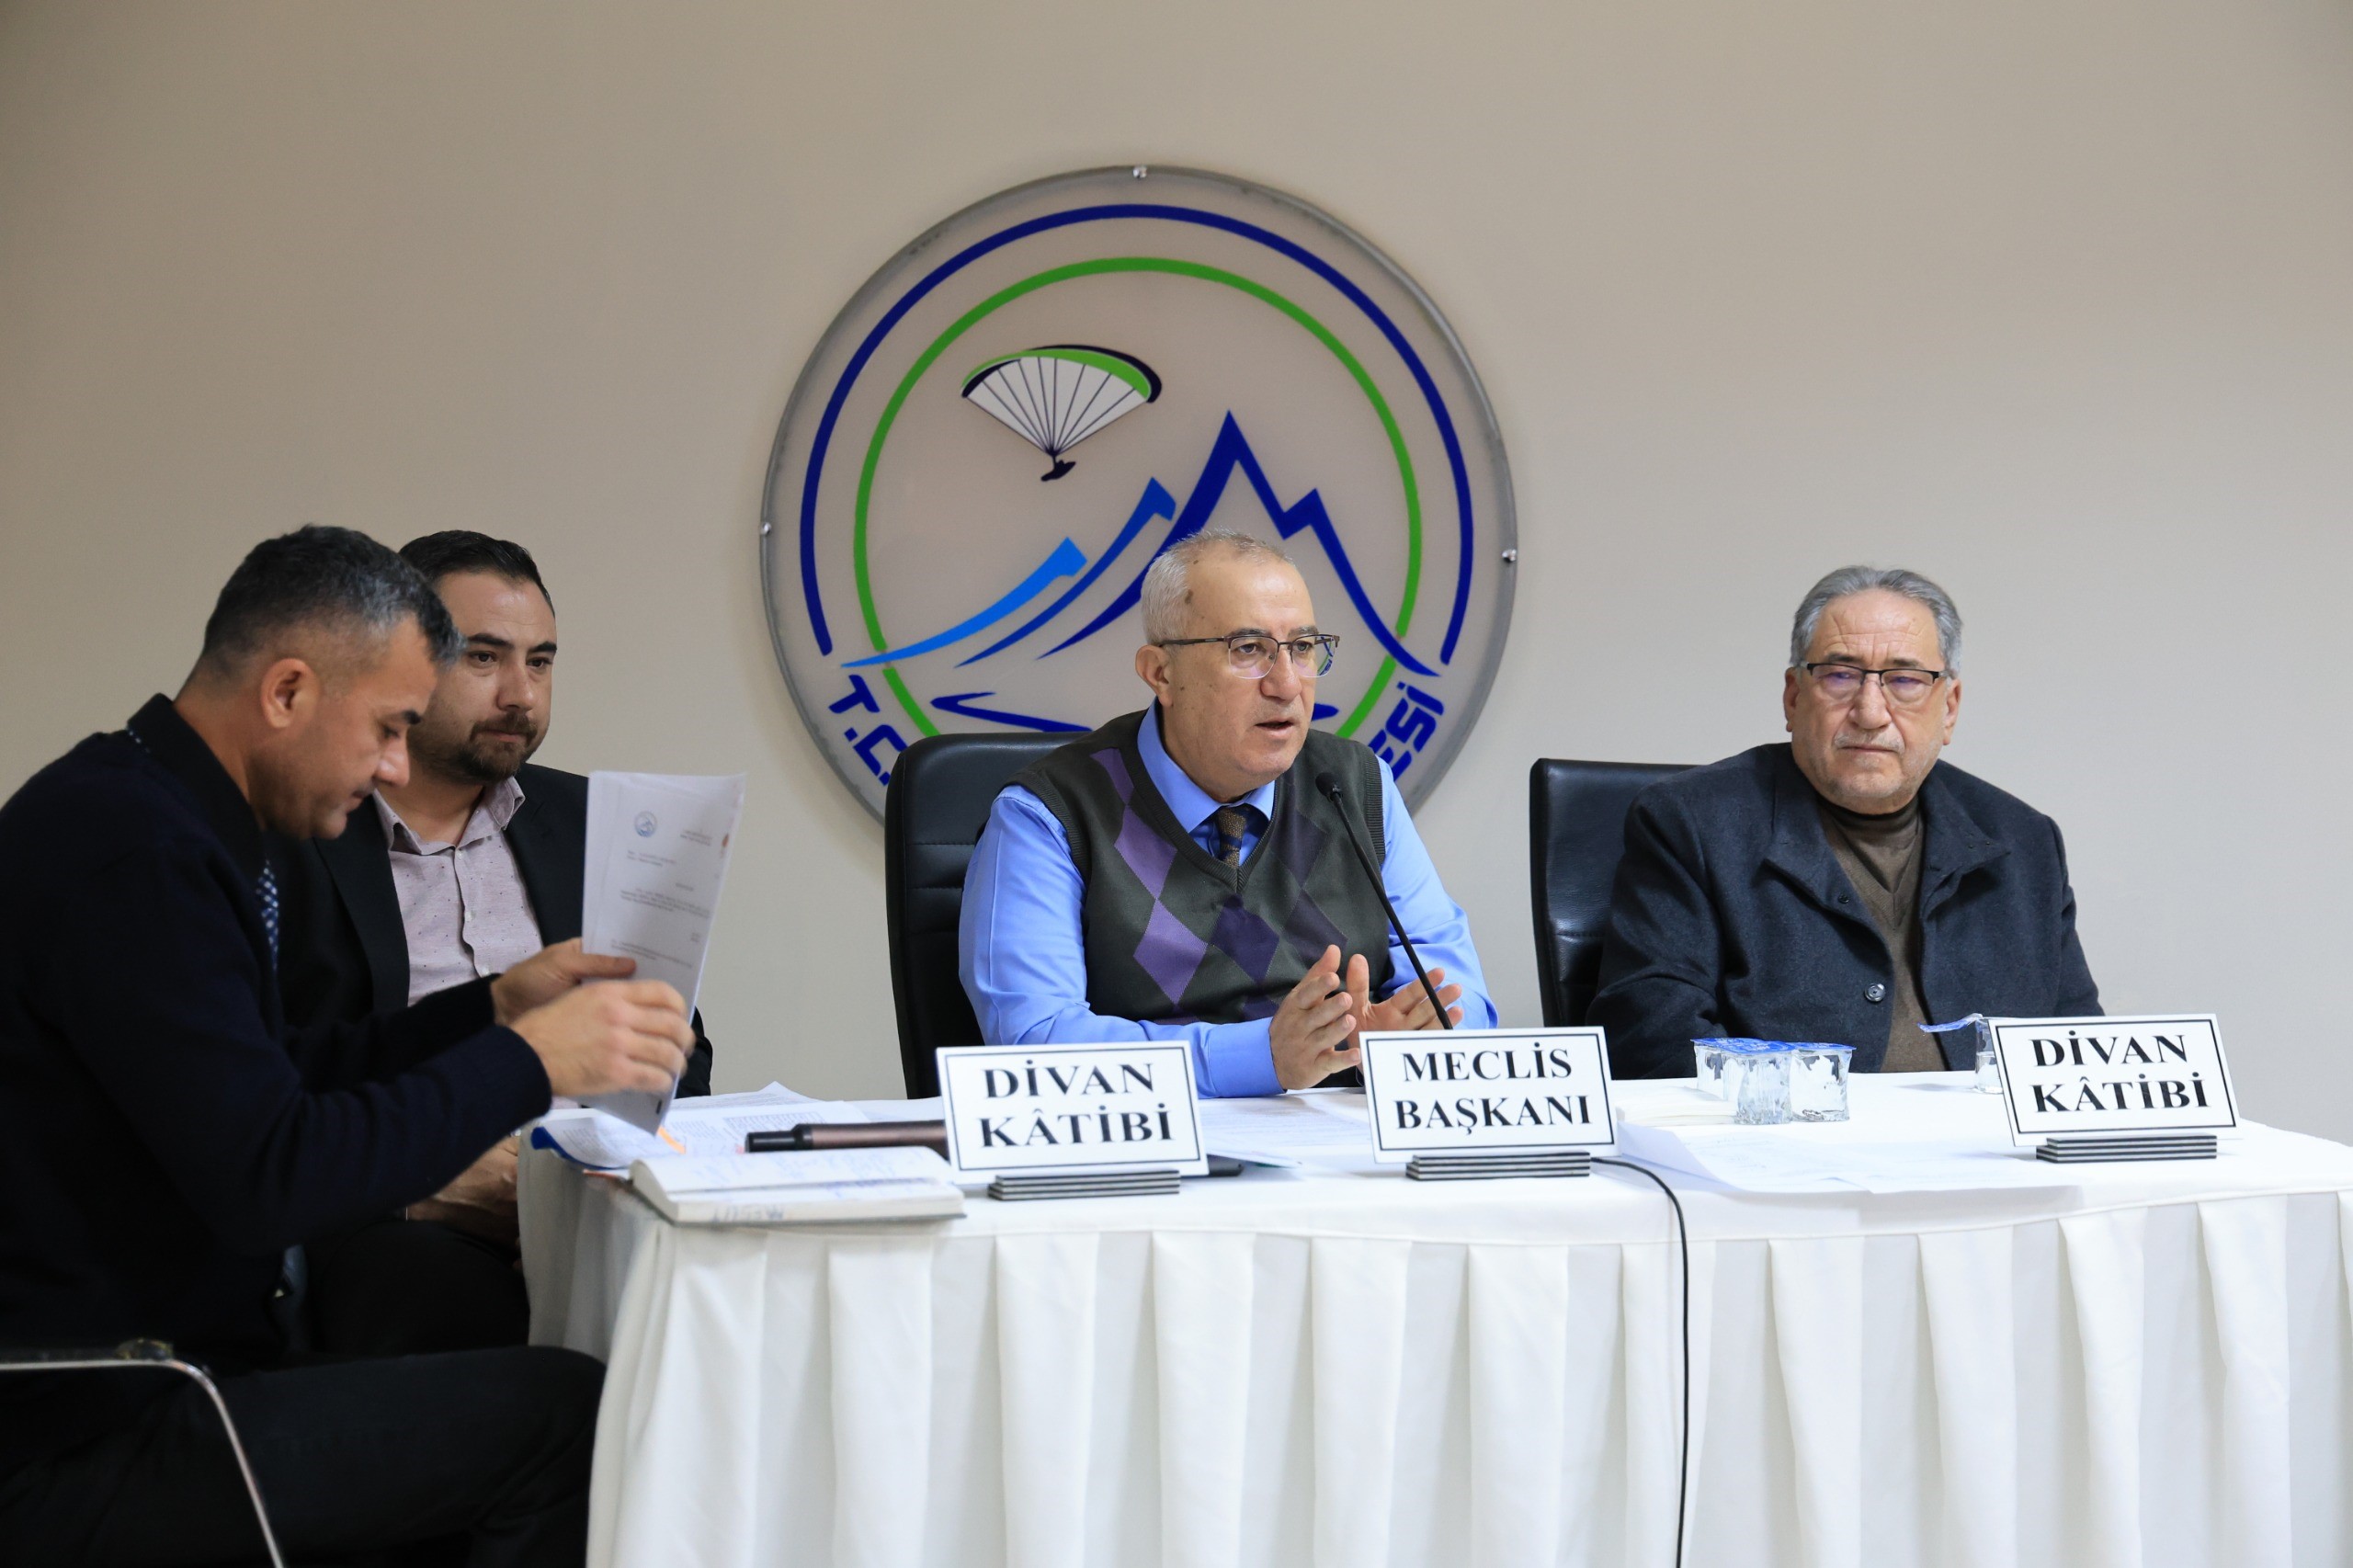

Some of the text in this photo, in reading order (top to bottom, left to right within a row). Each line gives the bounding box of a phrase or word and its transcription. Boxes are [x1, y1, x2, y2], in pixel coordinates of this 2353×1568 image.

[828, 674, 909, 787] T.C.
[1401, 1041, 1573, 1083] MECLİS
[2029, 1029, 2188, 1067] DİVAN
[983, 1059, 1154, 1099] DİVAN
[2029, 1071, 2212, 1114] KÂTİBİ
[979, 1102, 1176, 1148] KÂTİBİ
[1392, 1094, 1593, 1136] BAŞKANI
